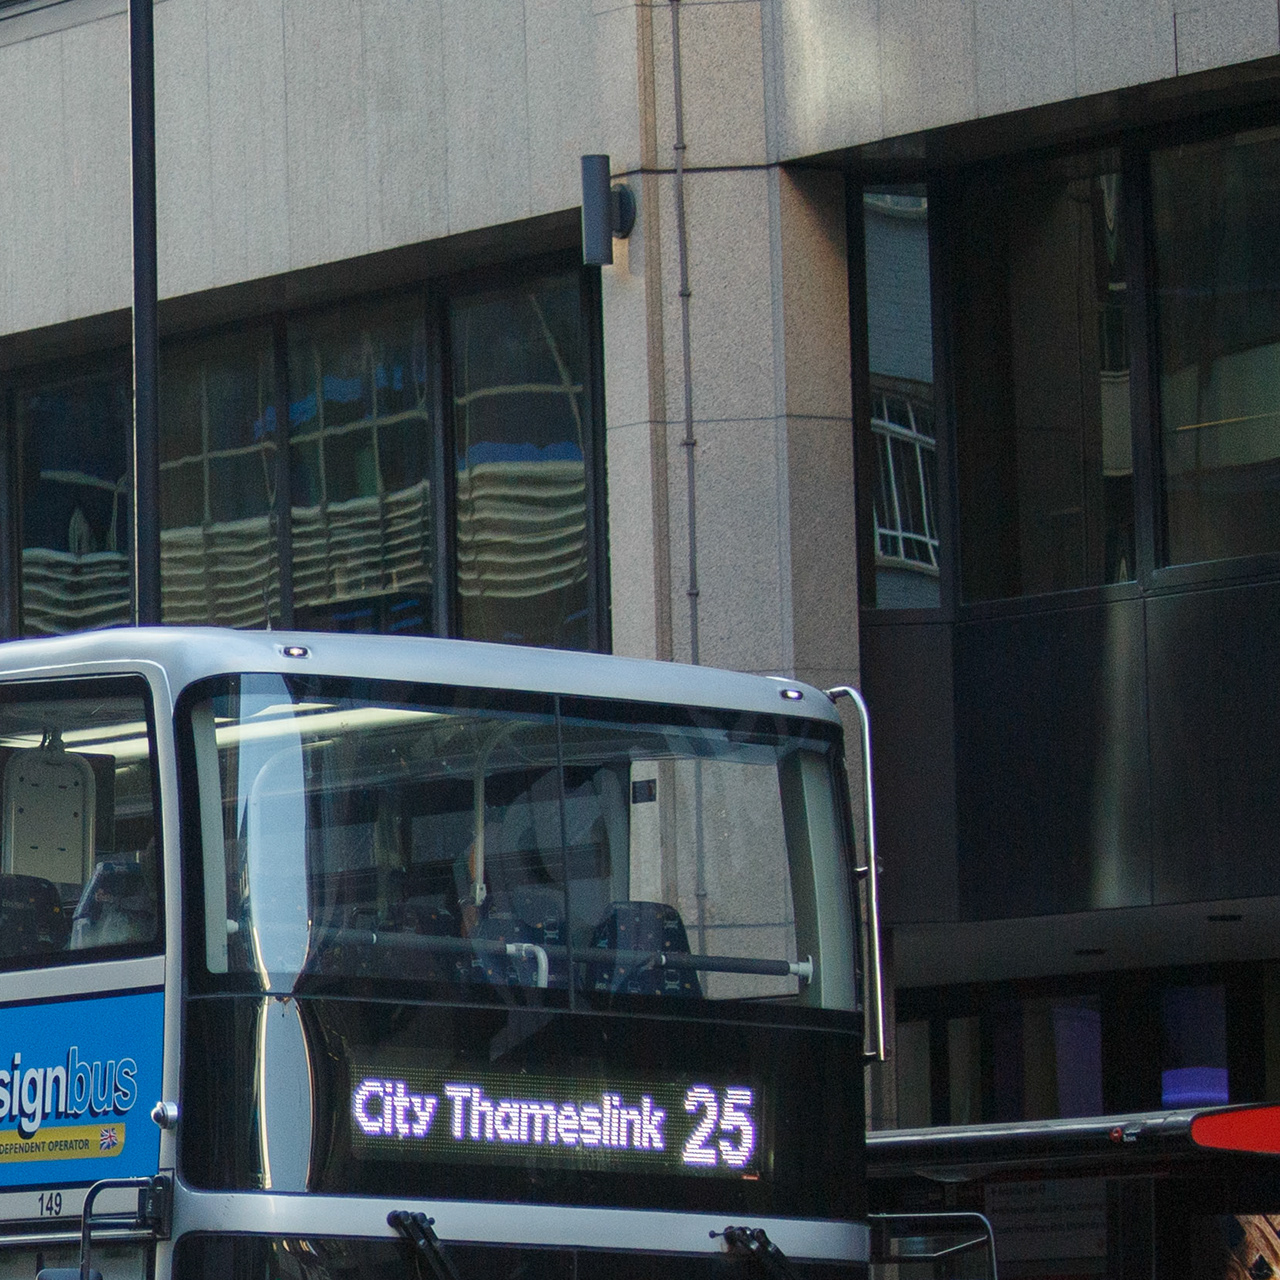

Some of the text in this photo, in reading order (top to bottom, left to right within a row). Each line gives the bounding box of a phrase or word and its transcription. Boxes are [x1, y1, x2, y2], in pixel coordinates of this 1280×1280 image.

[354, 1080, 755, 1167] City Thameslink 25
[47, 1139, 90, 1152] OPERATOR
[38, 1192, 62, 1216] 149
